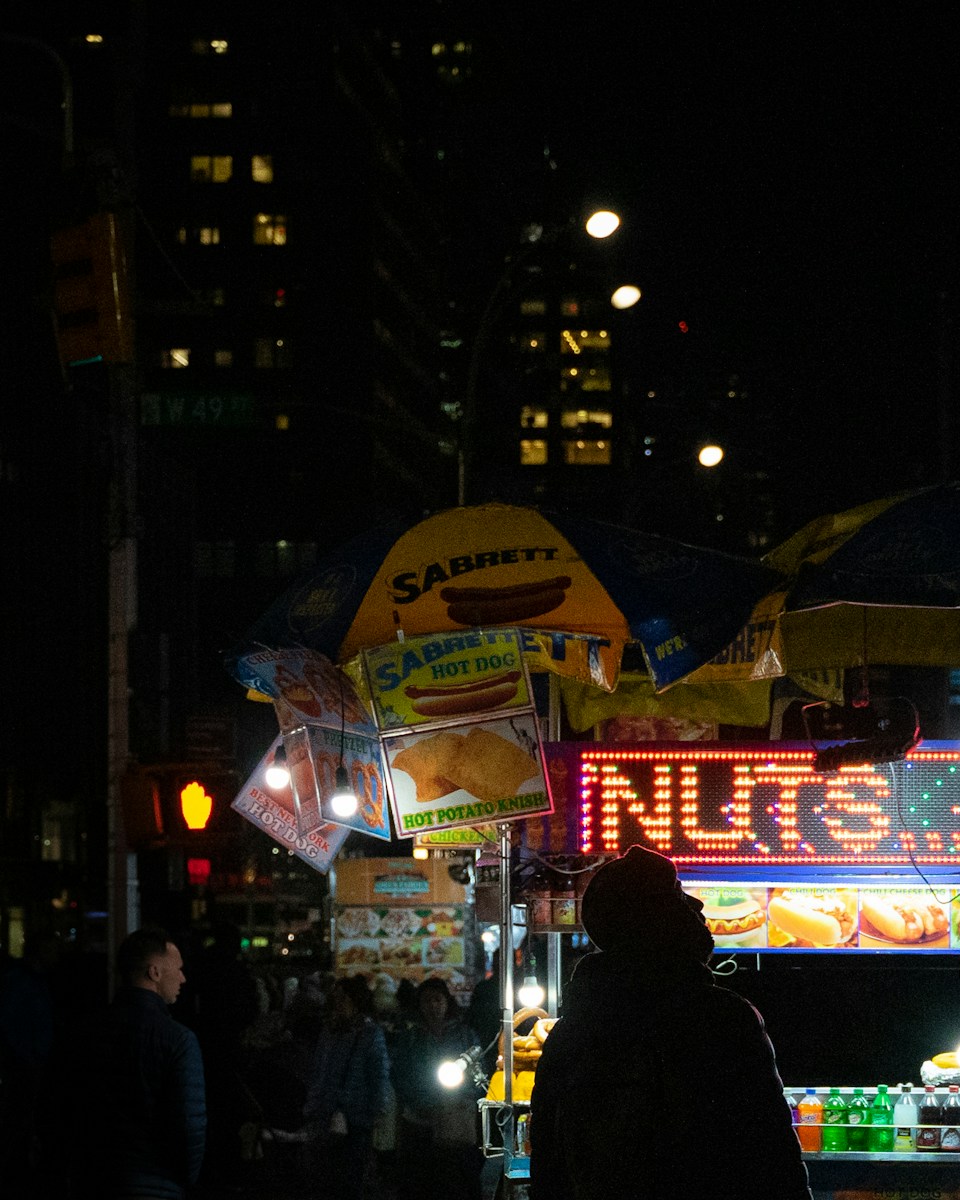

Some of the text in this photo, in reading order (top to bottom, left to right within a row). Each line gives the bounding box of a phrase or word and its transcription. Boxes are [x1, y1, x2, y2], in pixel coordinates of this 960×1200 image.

[191, 397, 223, 422] 49
[391, 547, 559, 605] SABRETT
[375, 631, 520, 693] SABRETT
[431, 651, 515, 680] HOT DOG
[249, 787, 278, 813] BEST
[403, 791, 546, 830] HOT POTATO KNISH
[248, 801, 284, 833] HOT
[282, 826, 320, 859] DOG
[909, 1184, 942, 1199] DOG
